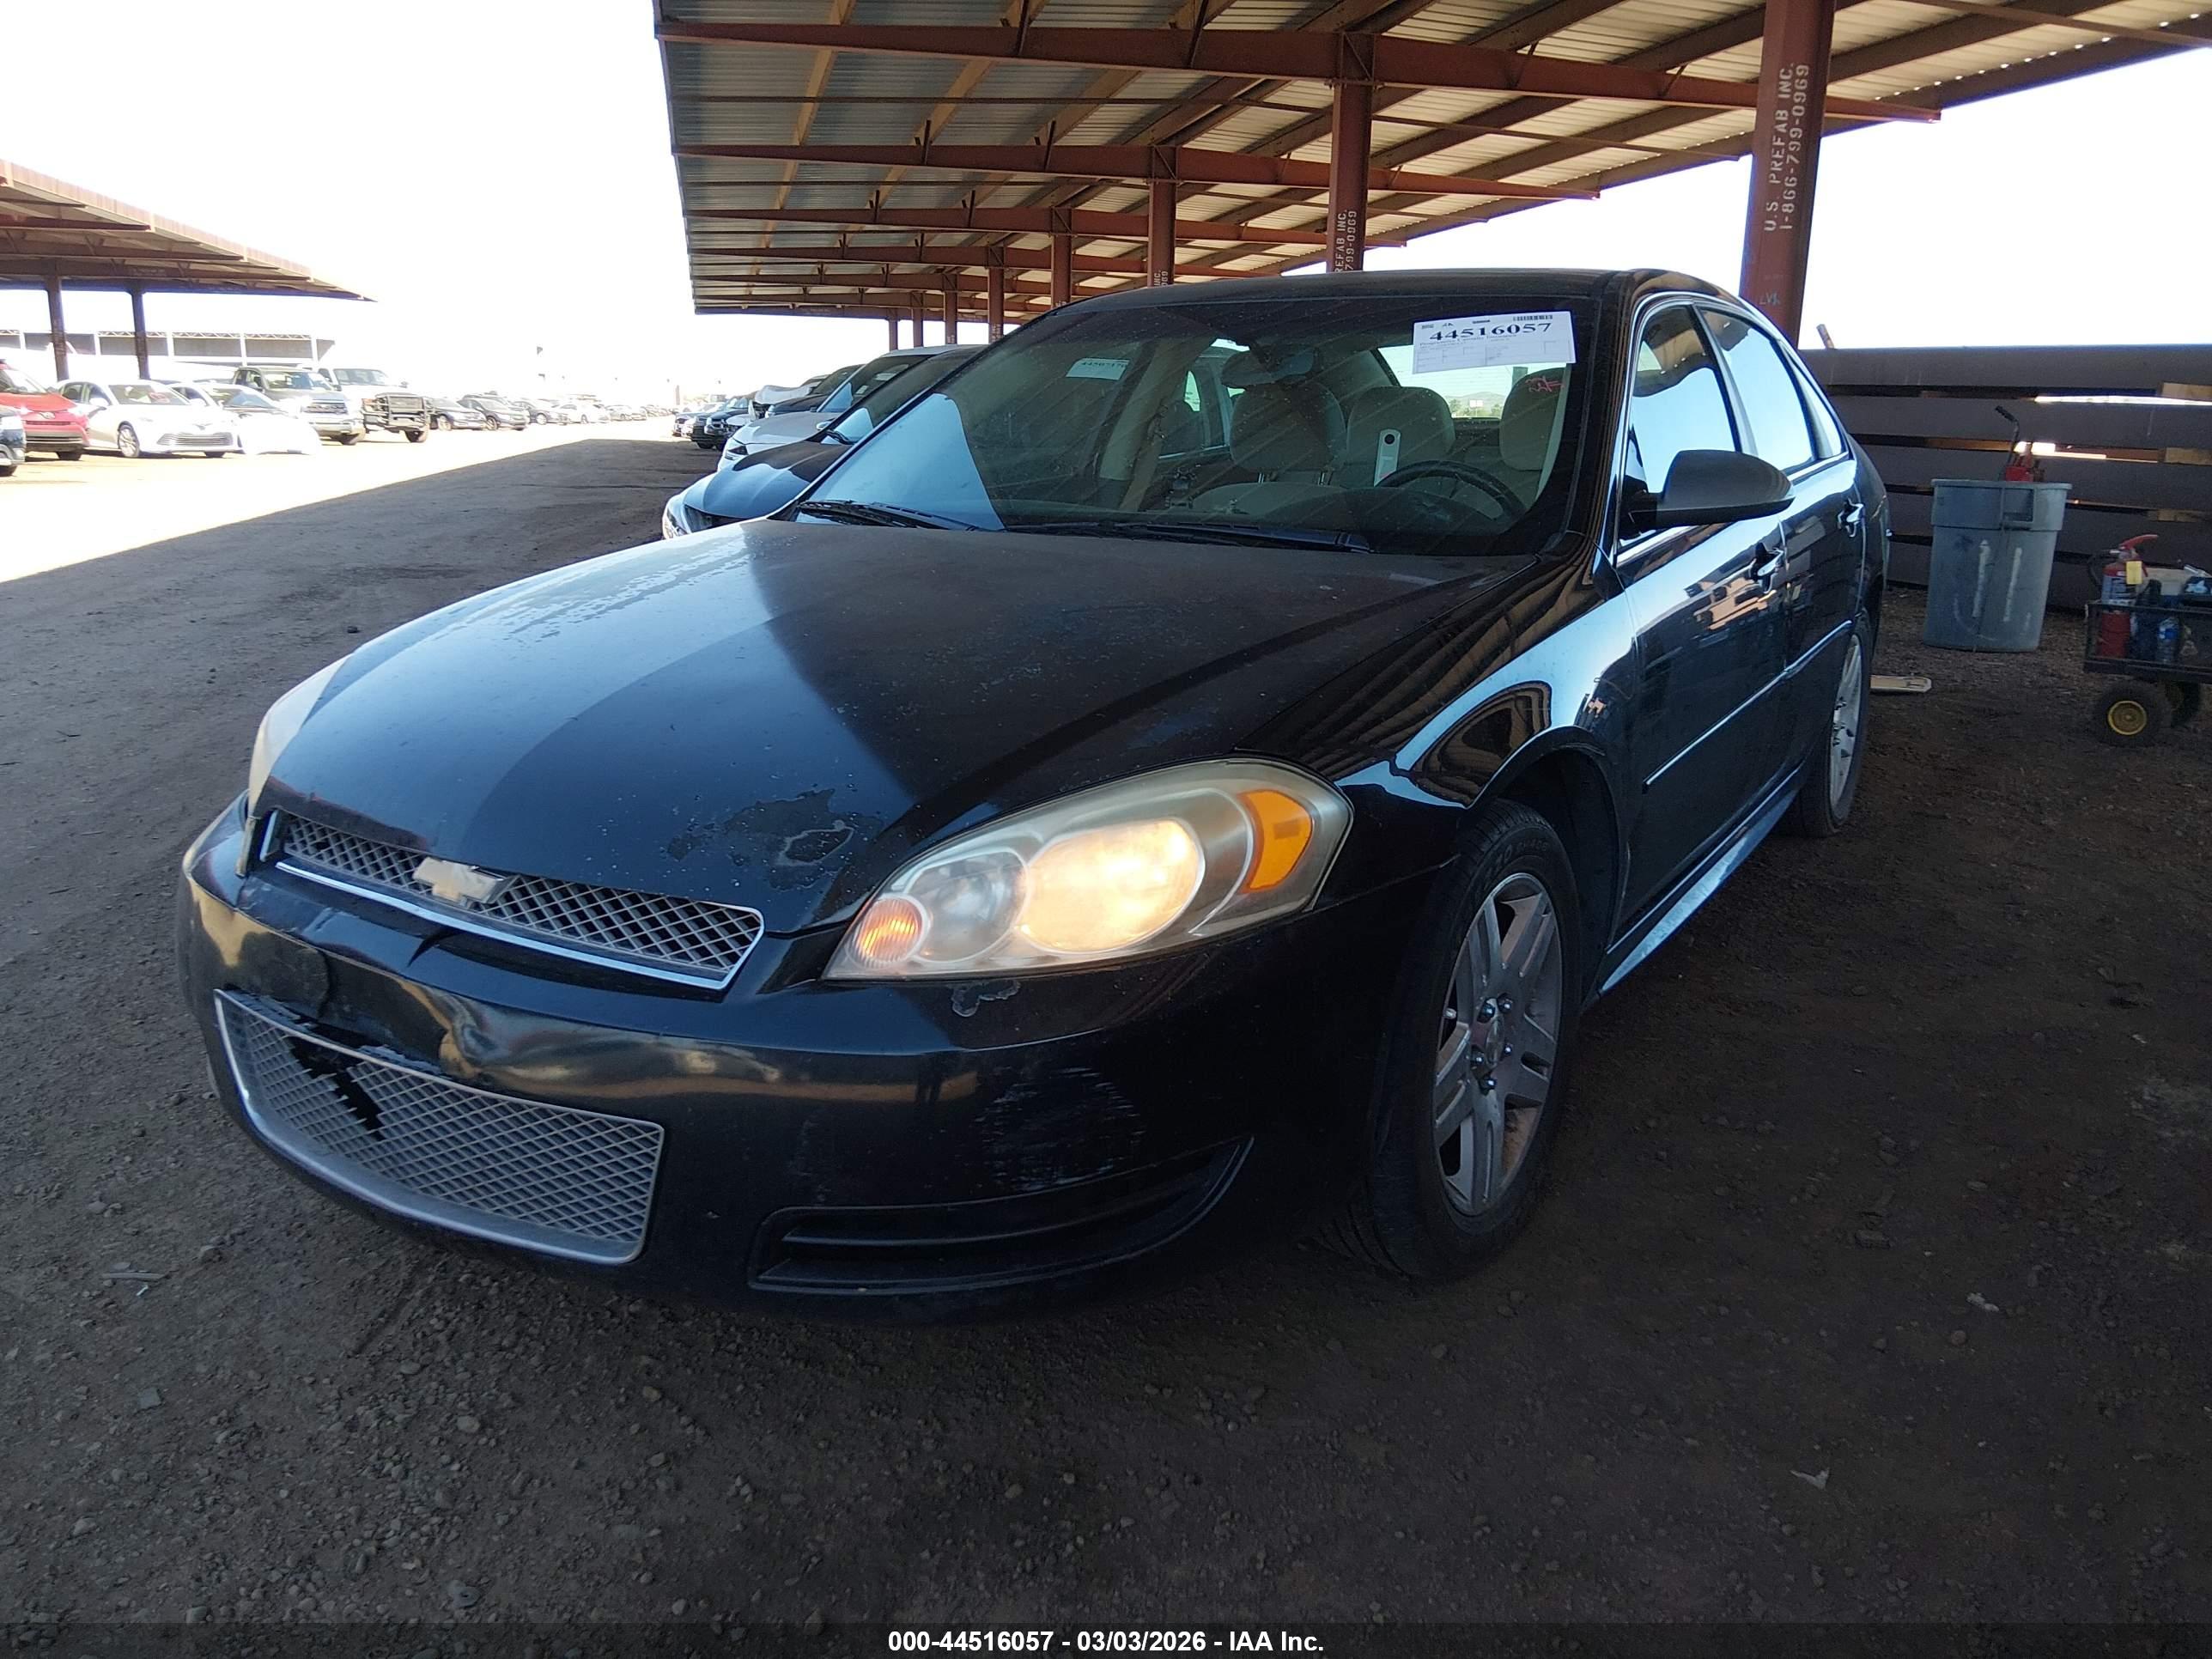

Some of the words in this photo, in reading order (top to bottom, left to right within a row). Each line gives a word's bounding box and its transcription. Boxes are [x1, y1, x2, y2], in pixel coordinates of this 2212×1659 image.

[1769, 109, 1789, 184] PREFAB
[1779, 64, 1809, 230] 1-866-799-0969
[1429, 322, 1553, 341] 44516057
